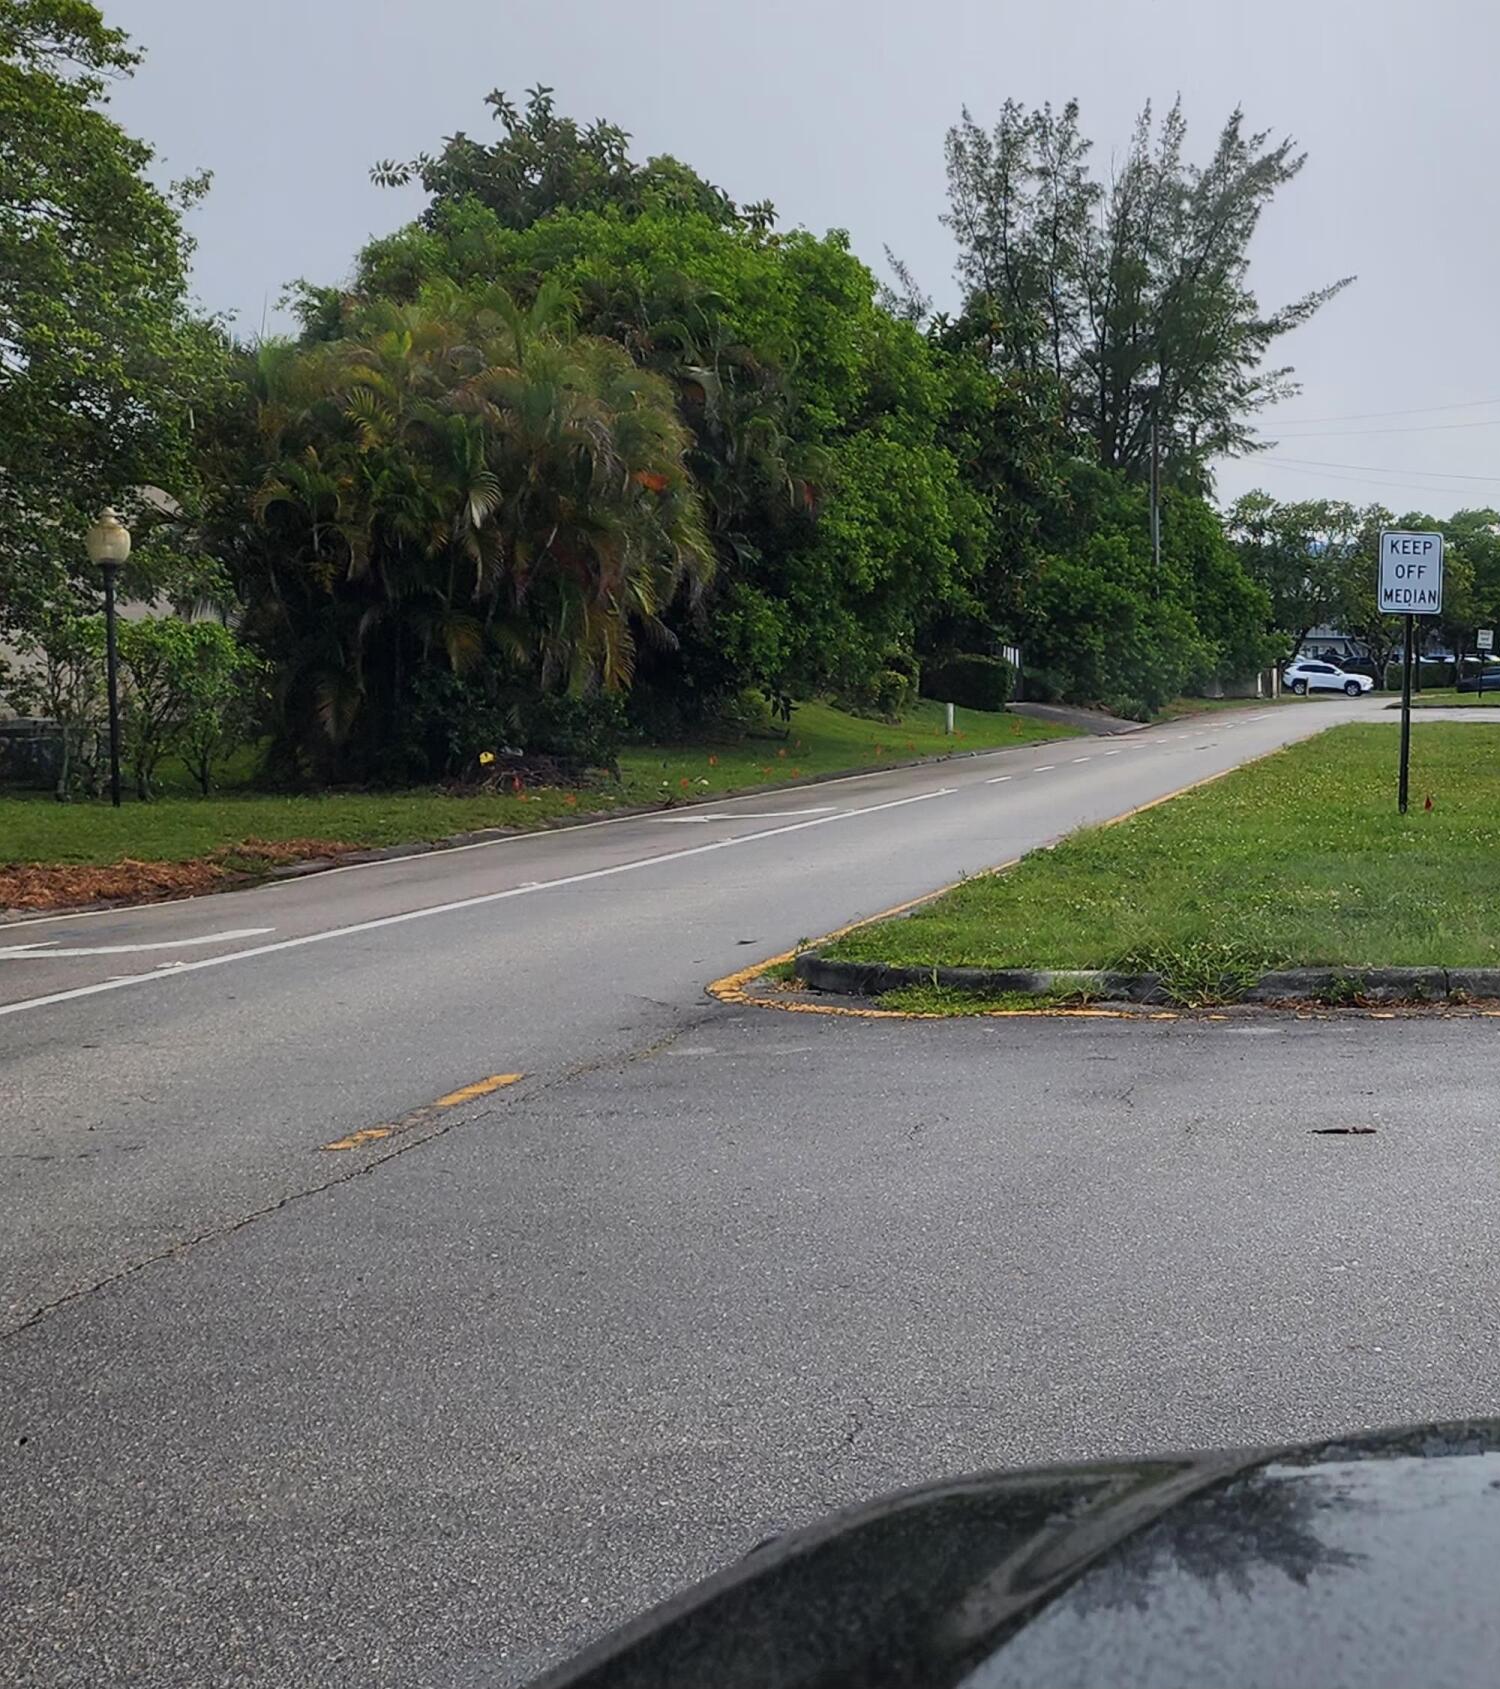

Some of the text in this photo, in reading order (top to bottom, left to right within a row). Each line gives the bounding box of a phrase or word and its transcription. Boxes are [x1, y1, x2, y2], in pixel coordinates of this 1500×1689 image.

[1390, 539, 1433, 555] KEEP
[1395, 564, 1427, 579] OFF
[1383, 588, 1437, 604] MEDIAN
